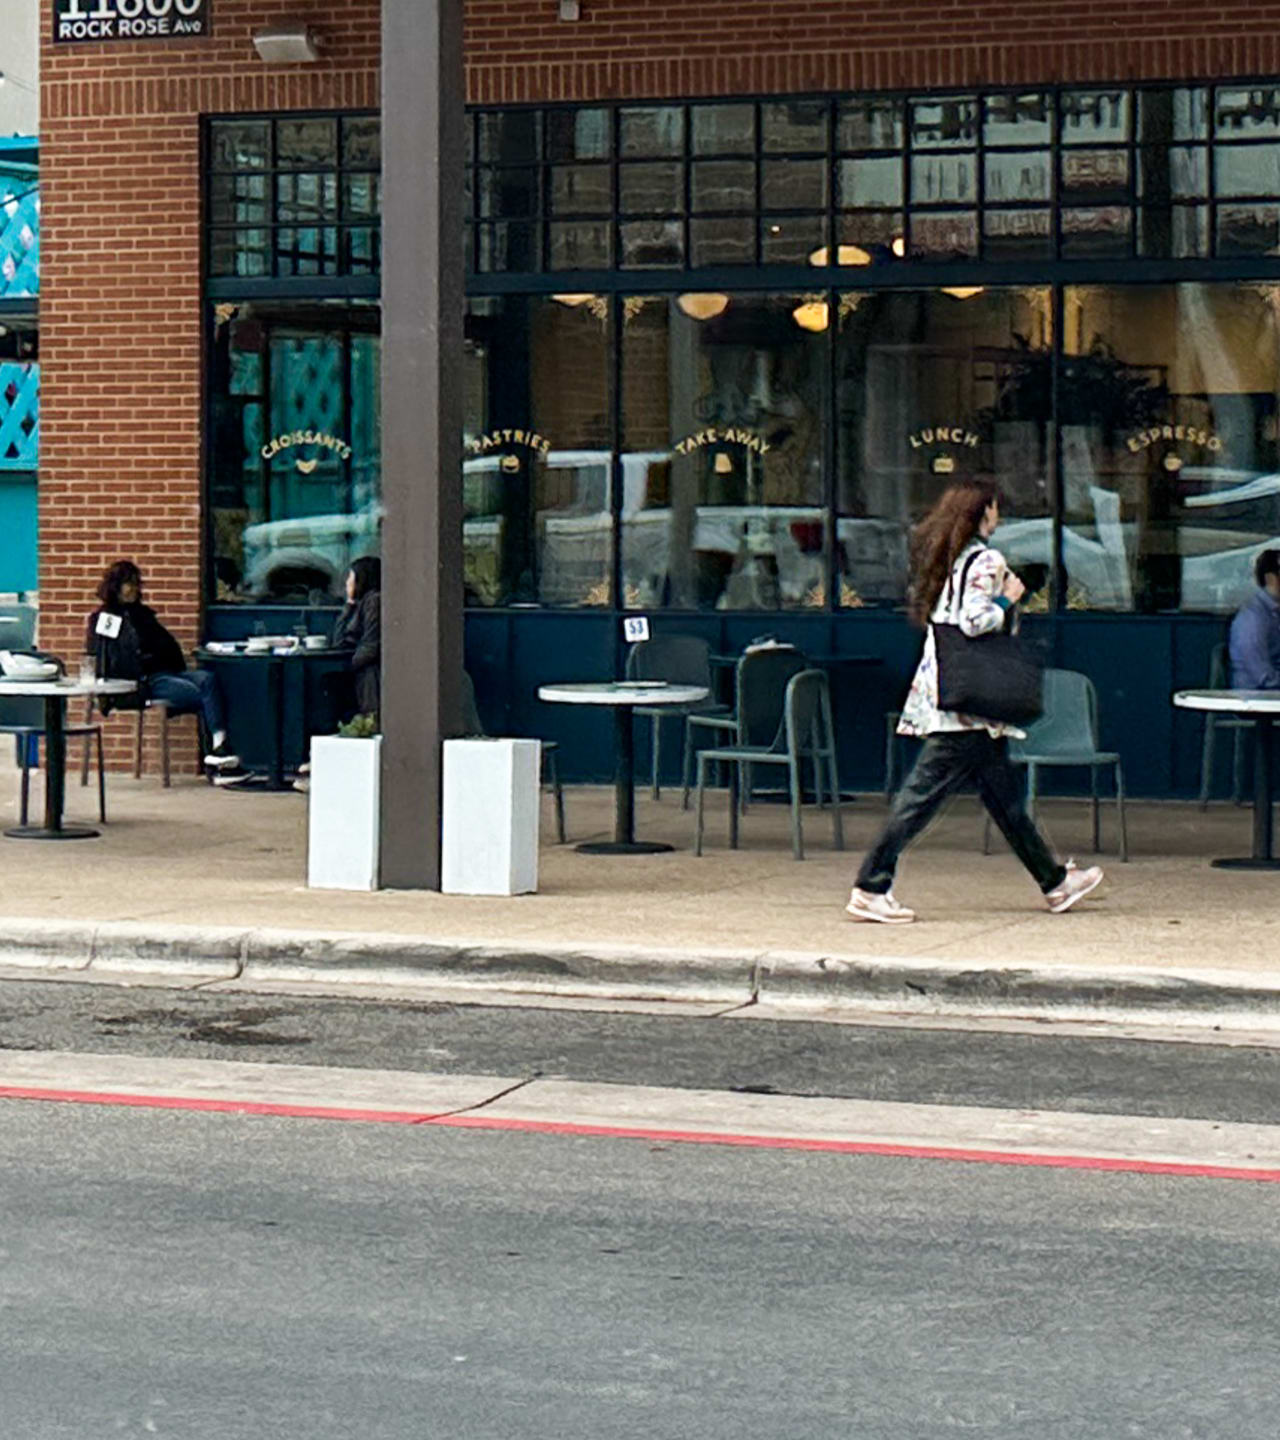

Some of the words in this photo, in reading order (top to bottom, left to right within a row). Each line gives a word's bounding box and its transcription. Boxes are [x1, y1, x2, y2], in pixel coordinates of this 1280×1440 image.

[59, 20, 113, 38] ROCK
[119, 18, 169, 36] ROSE
[173, 20, 202, 33] Ave
[261, 429, 352, 459] CROISSANTS
[471, 429, 551, 453] PASTRIES
[675, 428, 770, 455] TAKE-AWAY
[909, 427, 979, 448] LUNCH
[1128, 425, 1221, 452] ESPRESSO
